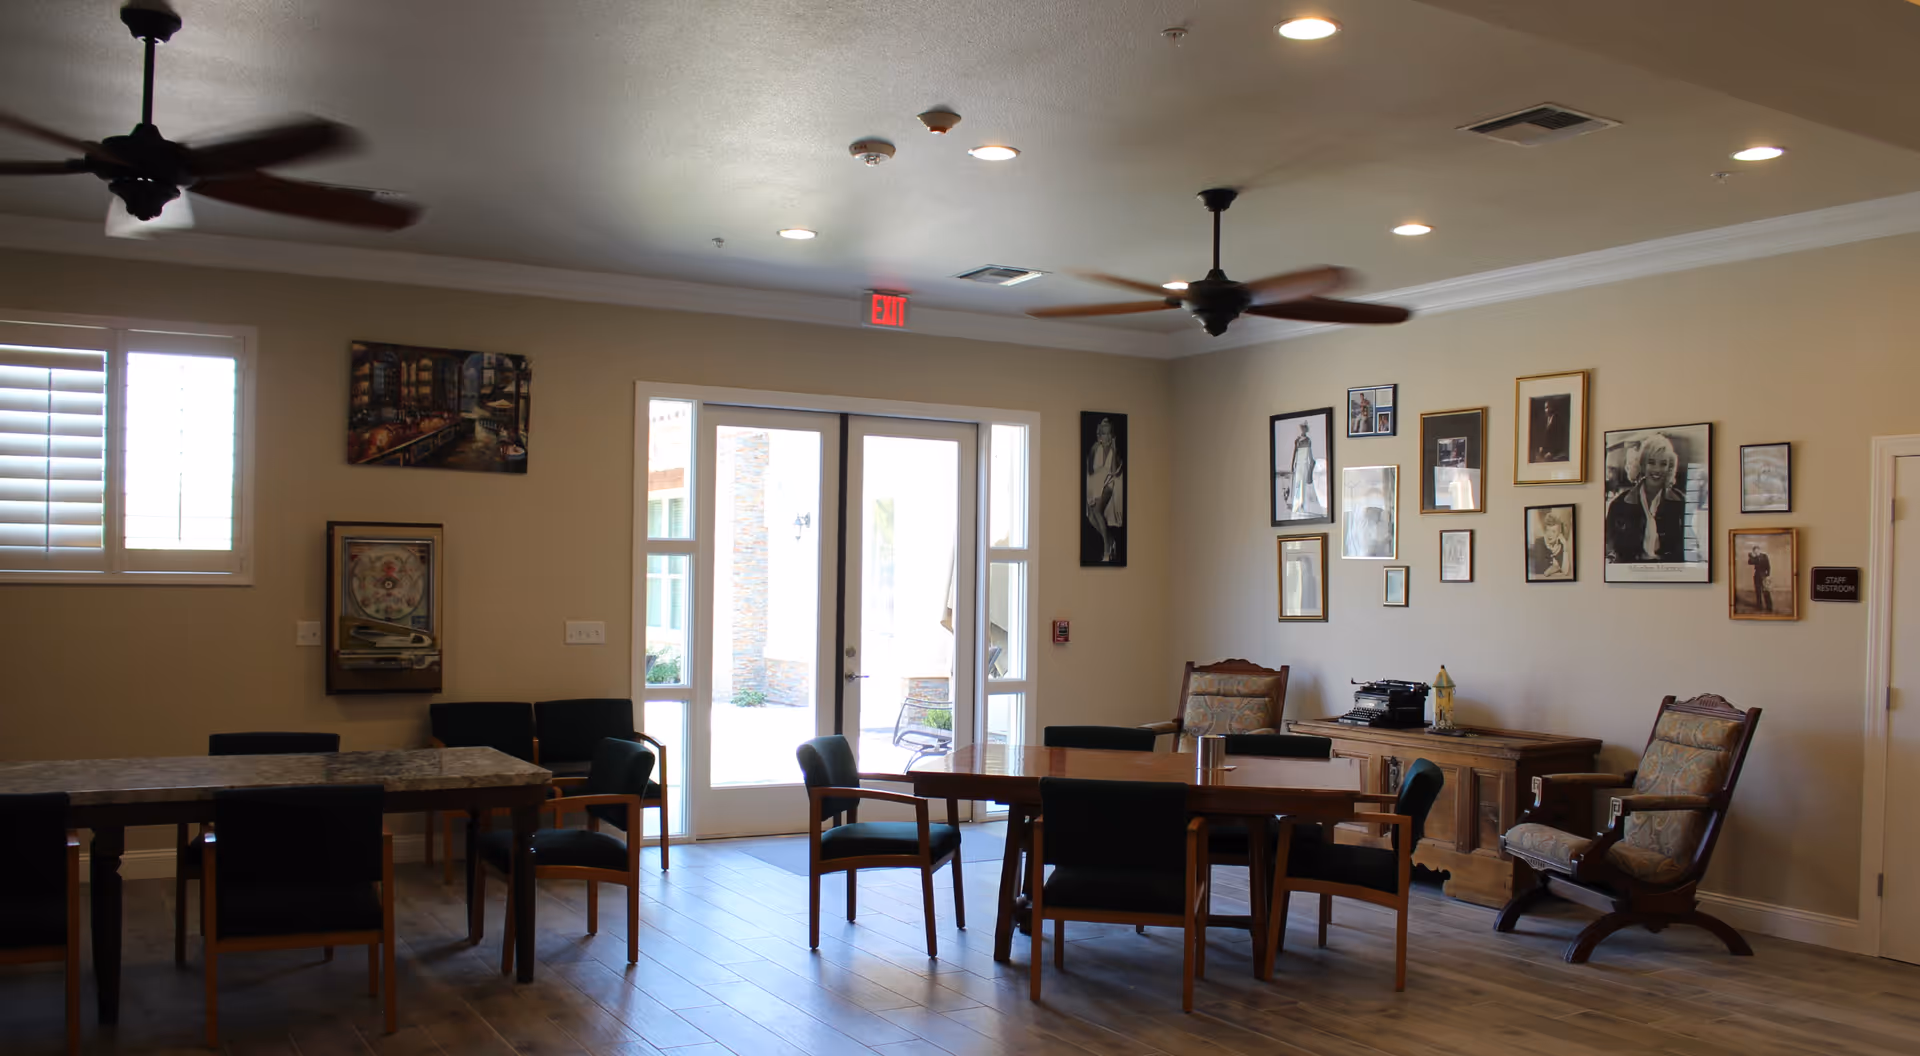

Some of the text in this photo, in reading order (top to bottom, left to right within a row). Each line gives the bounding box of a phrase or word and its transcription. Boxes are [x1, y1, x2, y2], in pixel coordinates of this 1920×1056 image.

[872, 294, 907, 327] EXIT
[1825, 576, 1847, 584] STAFF
[1816, 584, 1855, 593] RESTROOM
